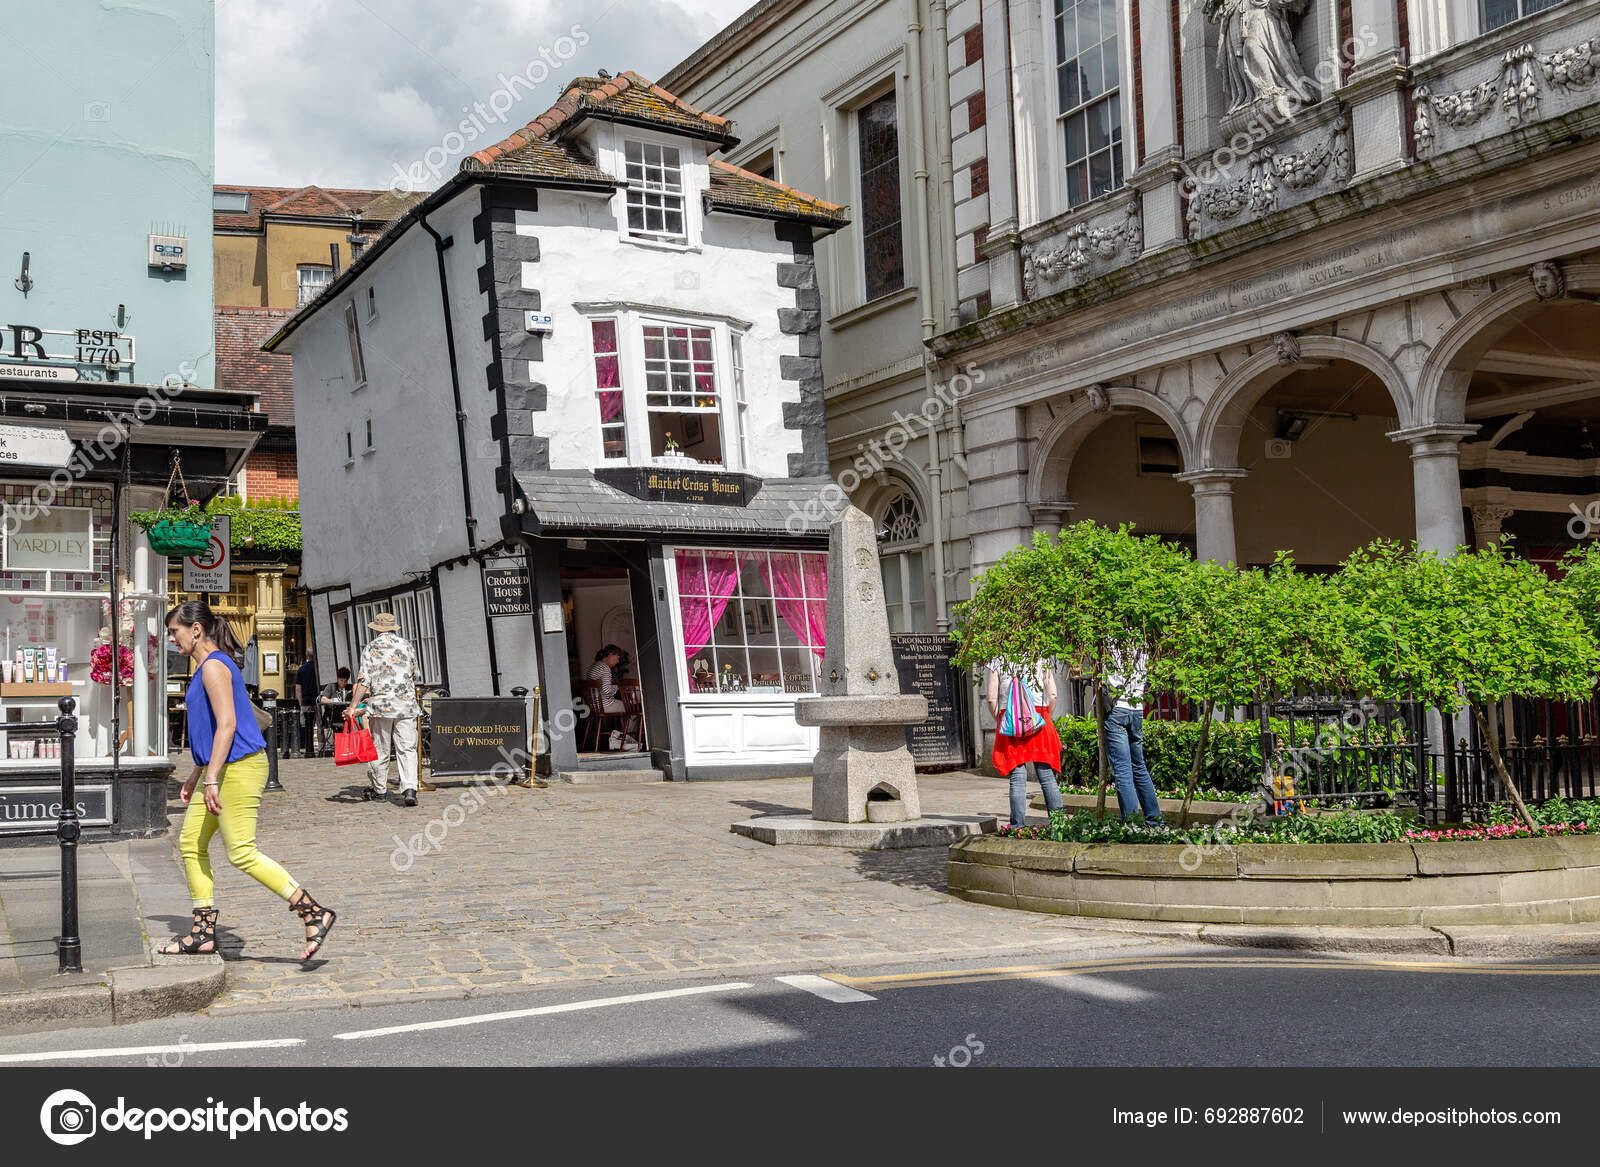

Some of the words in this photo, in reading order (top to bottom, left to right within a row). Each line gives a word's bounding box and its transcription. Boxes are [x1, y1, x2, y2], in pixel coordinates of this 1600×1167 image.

[0, 324, 49, 360] R
[75, 328, 118, 347] EST
[76, 346, 120, 365] 1770
[648, 474, 681, 491] Market
[681, 476, 709, 492] Cross
[711, 478, 740, 495] House
[9, 535, 86, 554] YARDLEY
[190, 571, 212, 579] Except
[486, 575, 529, 586] CROOKED
[493, 587, 524, 598] HOUSE
[489, 603, 531, 614] WINDSOR
[910, 644, 943, 652] WINDSOR
[727, 672, 743, 681] TEA
[785, 684, 810, 692] HOUSE
[435, 725, 452, 734] THE
[453, 724, 493, 734] CROOKED
[494, 724, 521, 733] HOUSE
[453, 737, 465, 746] OF
[466, 737, 505, 746] WINDSOR
[0, 796, 87, 820] umes
